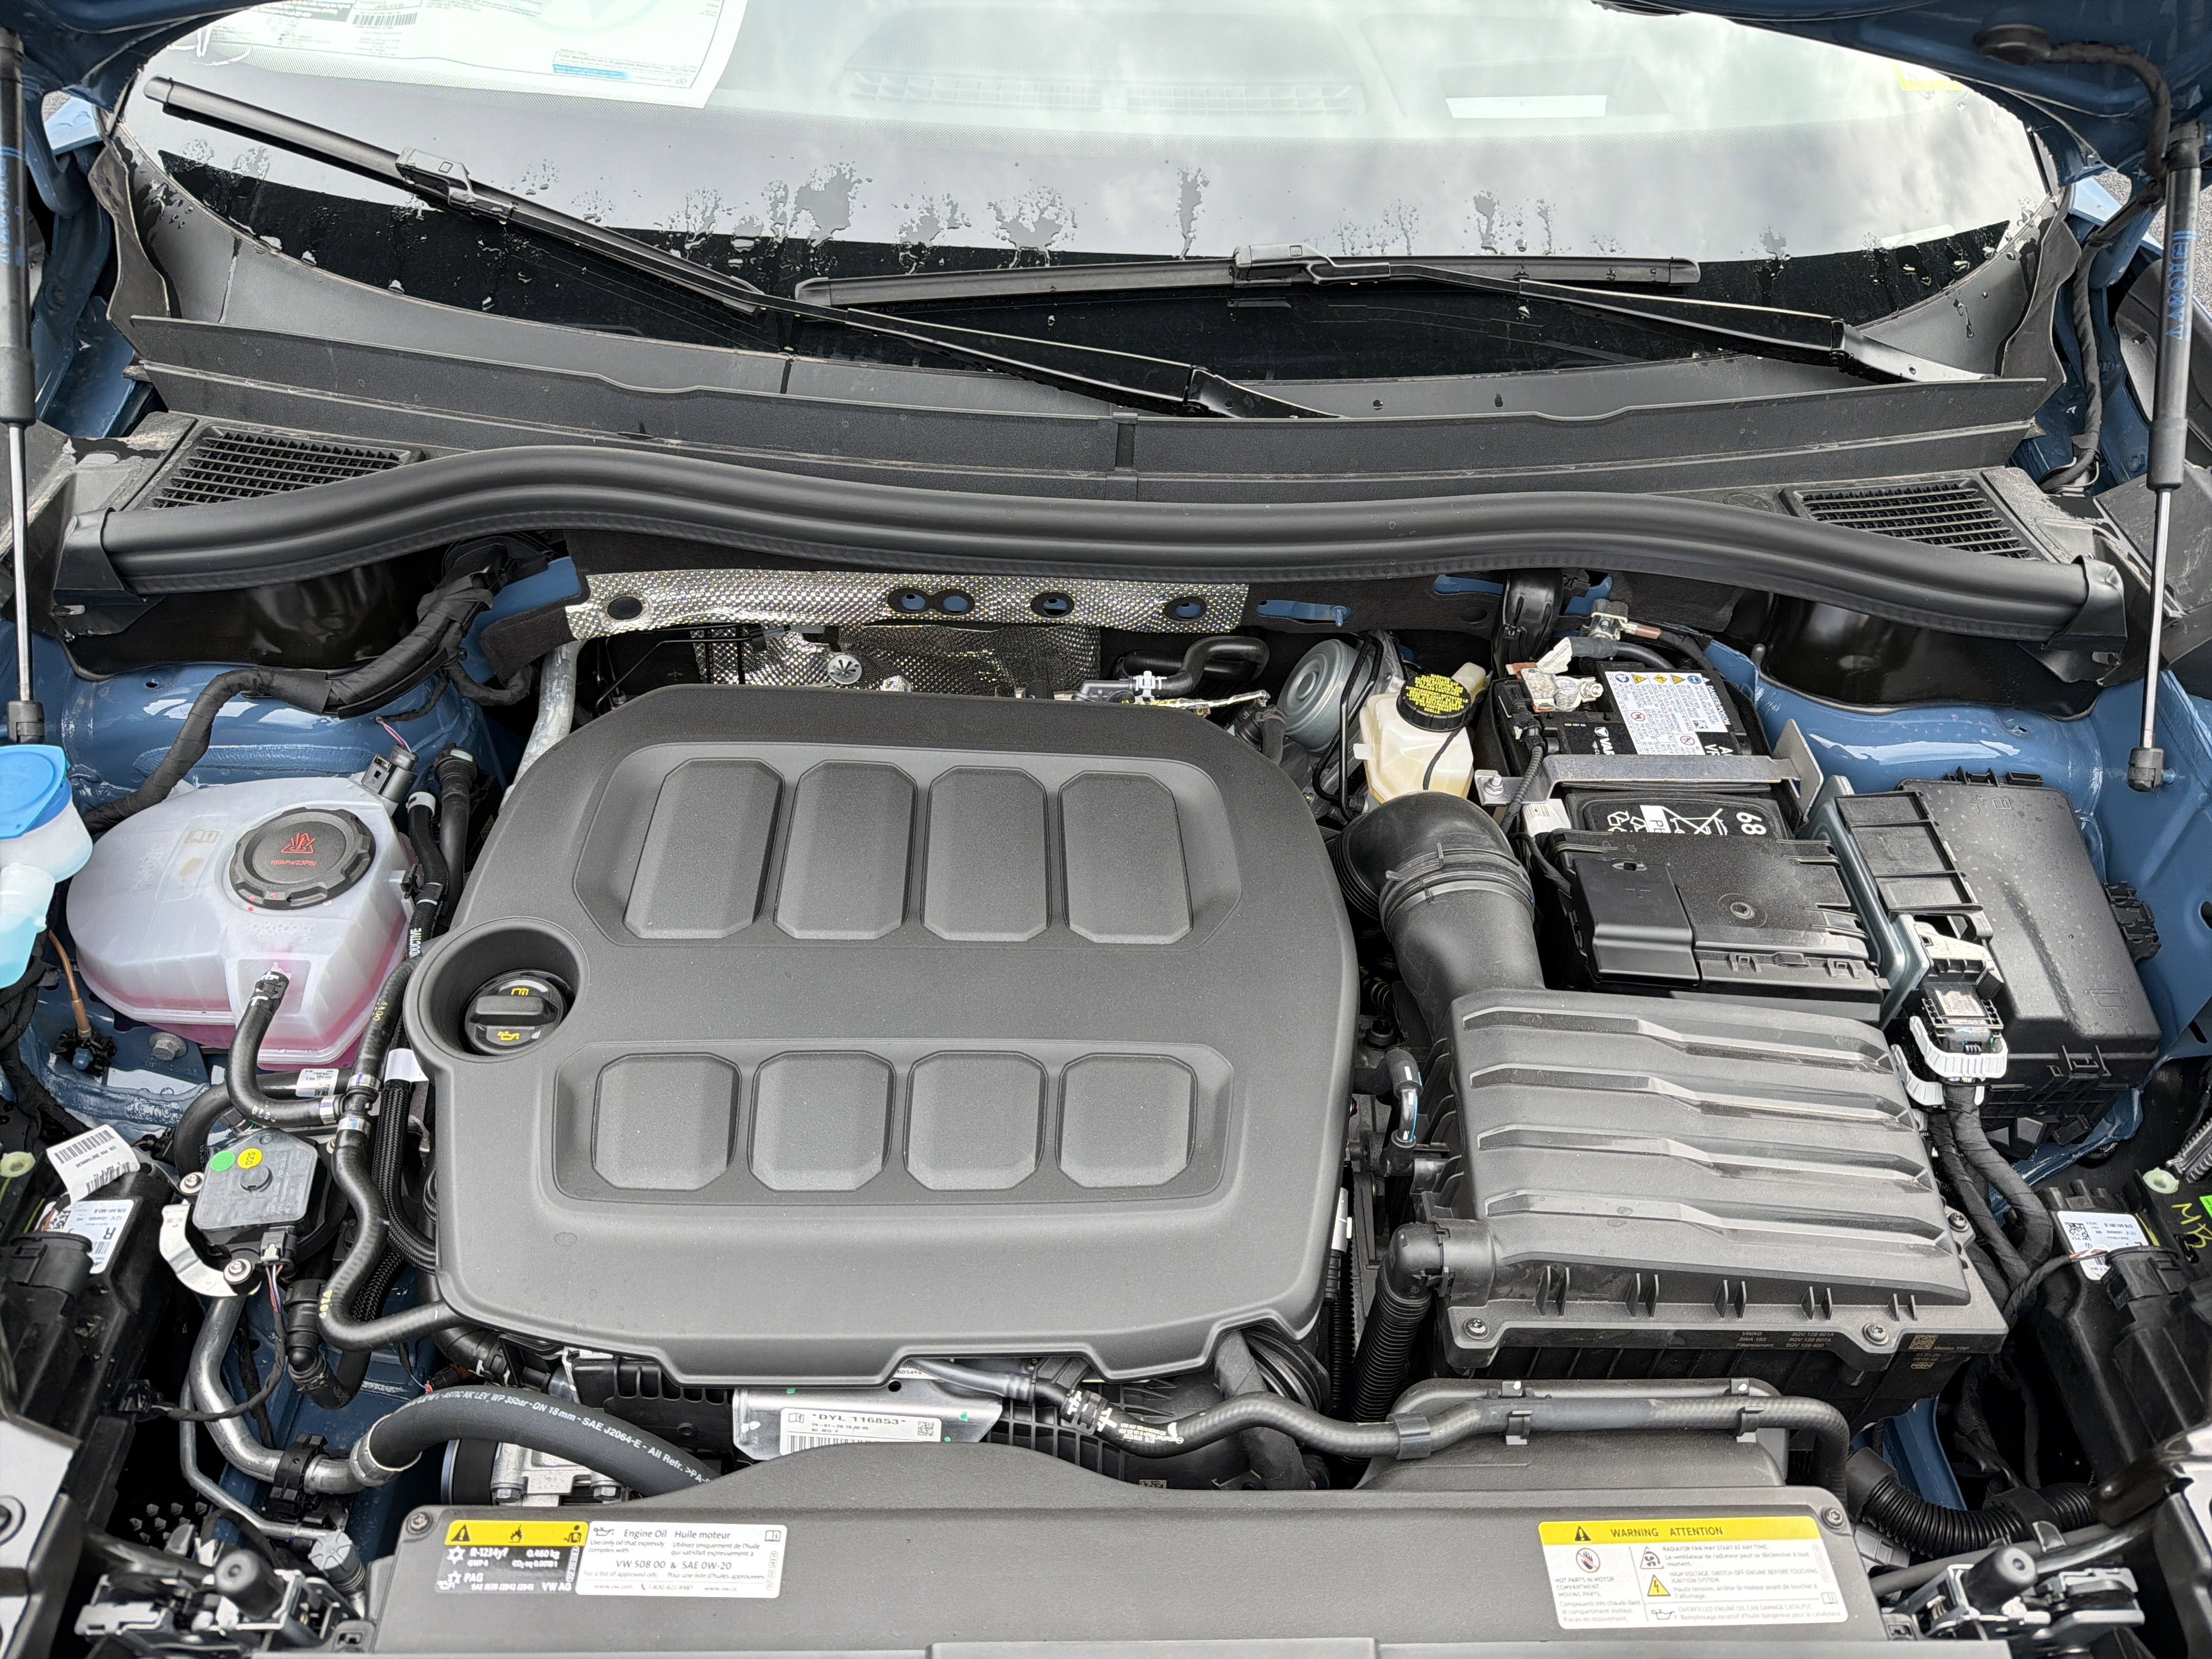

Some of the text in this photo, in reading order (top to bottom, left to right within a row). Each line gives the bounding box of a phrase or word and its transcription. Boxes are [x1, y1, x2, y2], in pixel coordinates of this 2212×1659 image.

[1707, 685, 1731, 725] DANGER/POISON
[1736, 812, 1767, 835] 68
[103, 1227, 116, 1239] R
[492, 1394, 505, 1403] WP
[548, 1406, 575, 1421] 18mm
[582, 1417, 604, 1432] SAE
[603, 1426, 642, 1449] J2064-E
[648, 1446, 663, 1459] All
[662, 1453, 683, 1471] Refr.
[623, 1529, 653, 1539] Engine
[674, 1530, 697, 1538] Huile
[699, 1531, 731, 1539] moteur
[1610, 1527, 1723, 1538] WARNING ATTENTION
[634, 1560, 651, 1568] 508
[681, 1561, 699, 1570] SAE
[701, 1562, 732, 1570] 0W-20
[463, 1573, 484, 1582] PAG
[542, 1582, 572, 1592] VW AG
